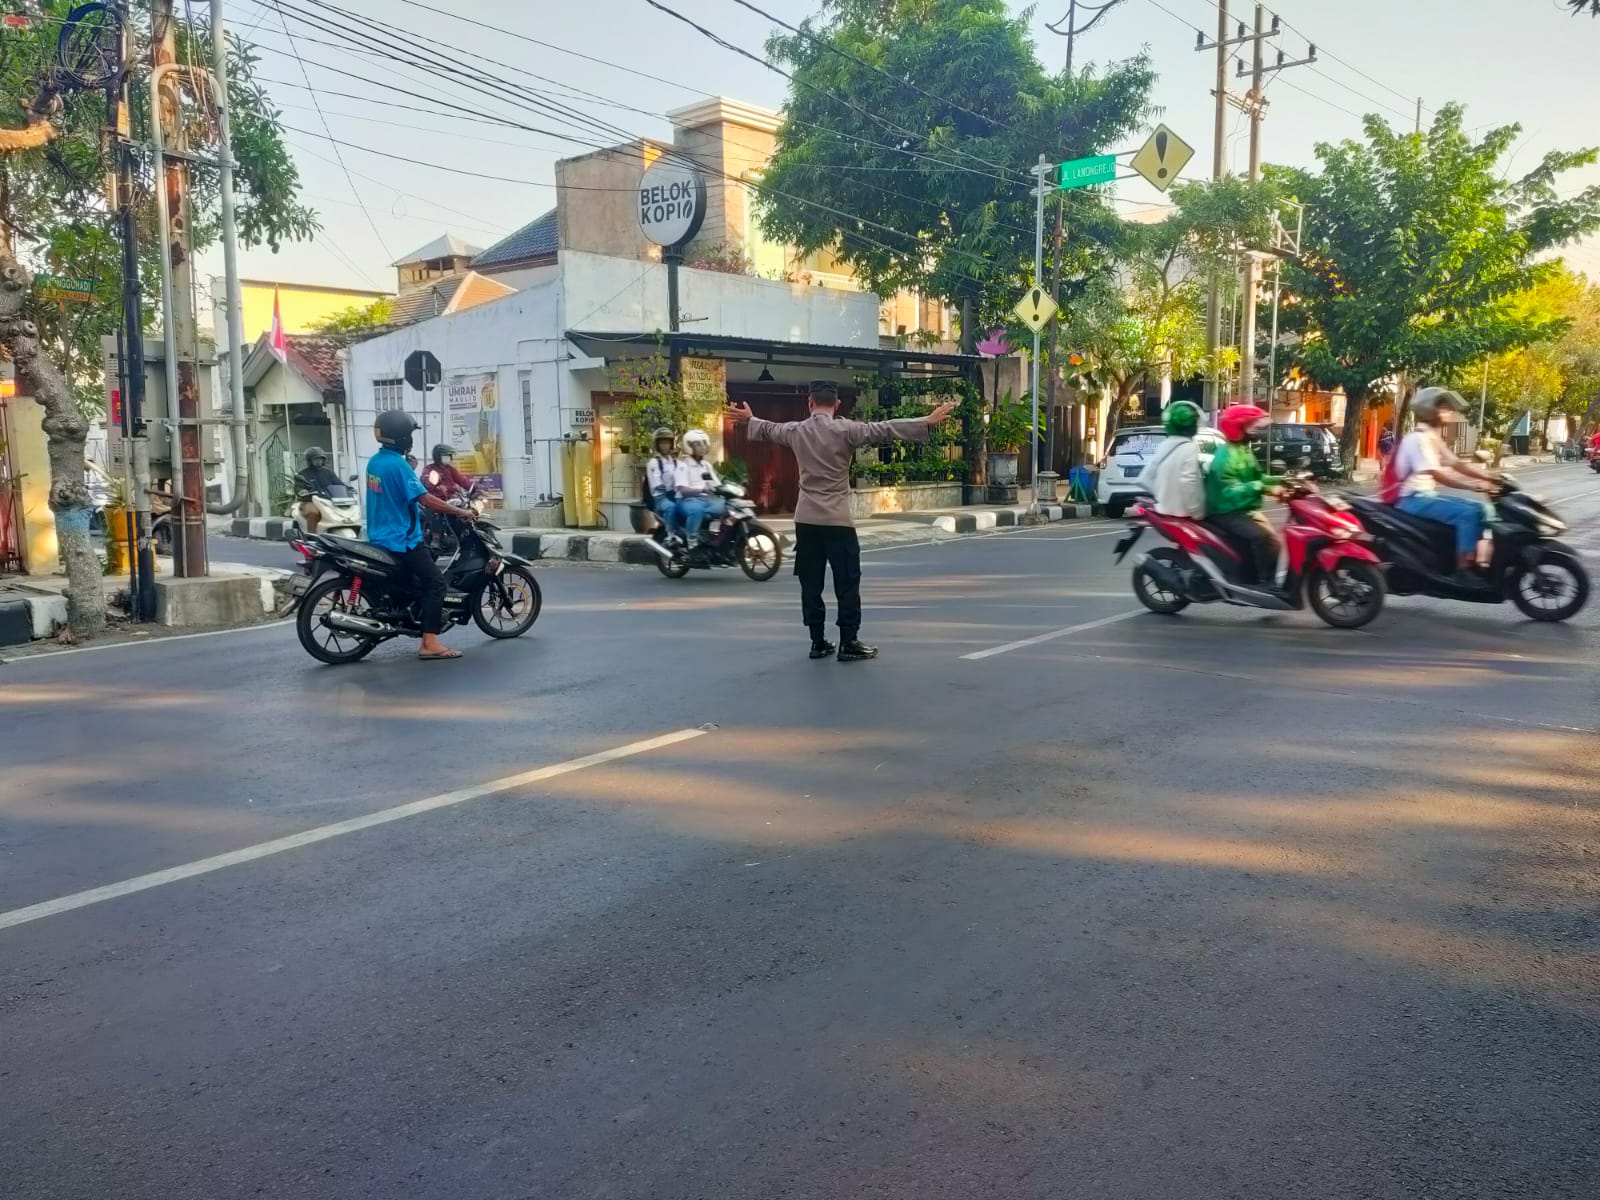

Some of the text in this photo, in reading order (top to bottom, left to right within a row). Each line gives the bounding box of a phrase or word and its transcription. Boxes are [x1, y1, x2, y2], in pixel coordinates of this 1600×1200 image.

[1072, 161, 1116, 179] LAMONGREJO
[640, 180, 692, 206] BELOK
[641, 201, 681, 225] KOPI
[448, 384, 477, 397] UMRAH
[449, 395, 477, 403] MAULID
